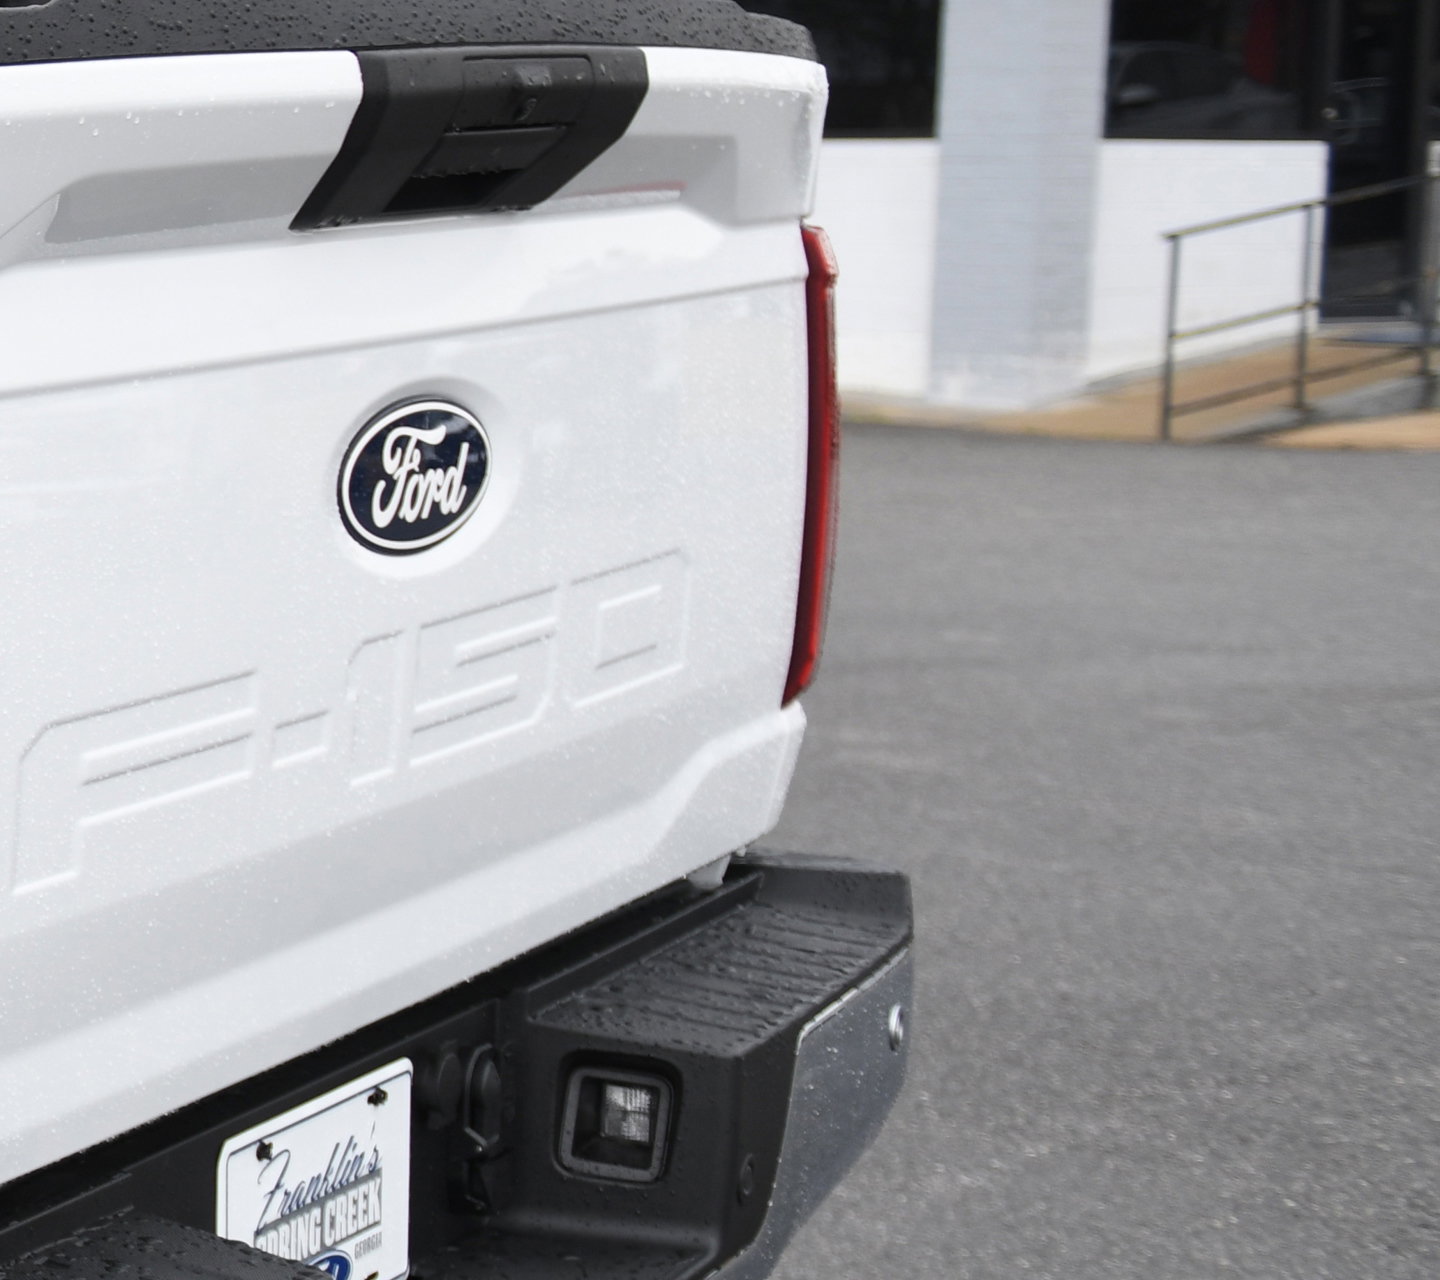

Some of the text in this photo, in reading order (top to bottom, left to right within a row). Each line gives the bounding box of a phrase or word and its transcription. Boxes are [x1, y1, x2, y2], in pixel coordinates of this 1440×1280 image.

[371, 424, 470, 528] Ford
[10, 547, 692, 896] F-150
[255, 1119, 382, 1235] Franklin's
[323, 1177, 382, 1248] CREEK
